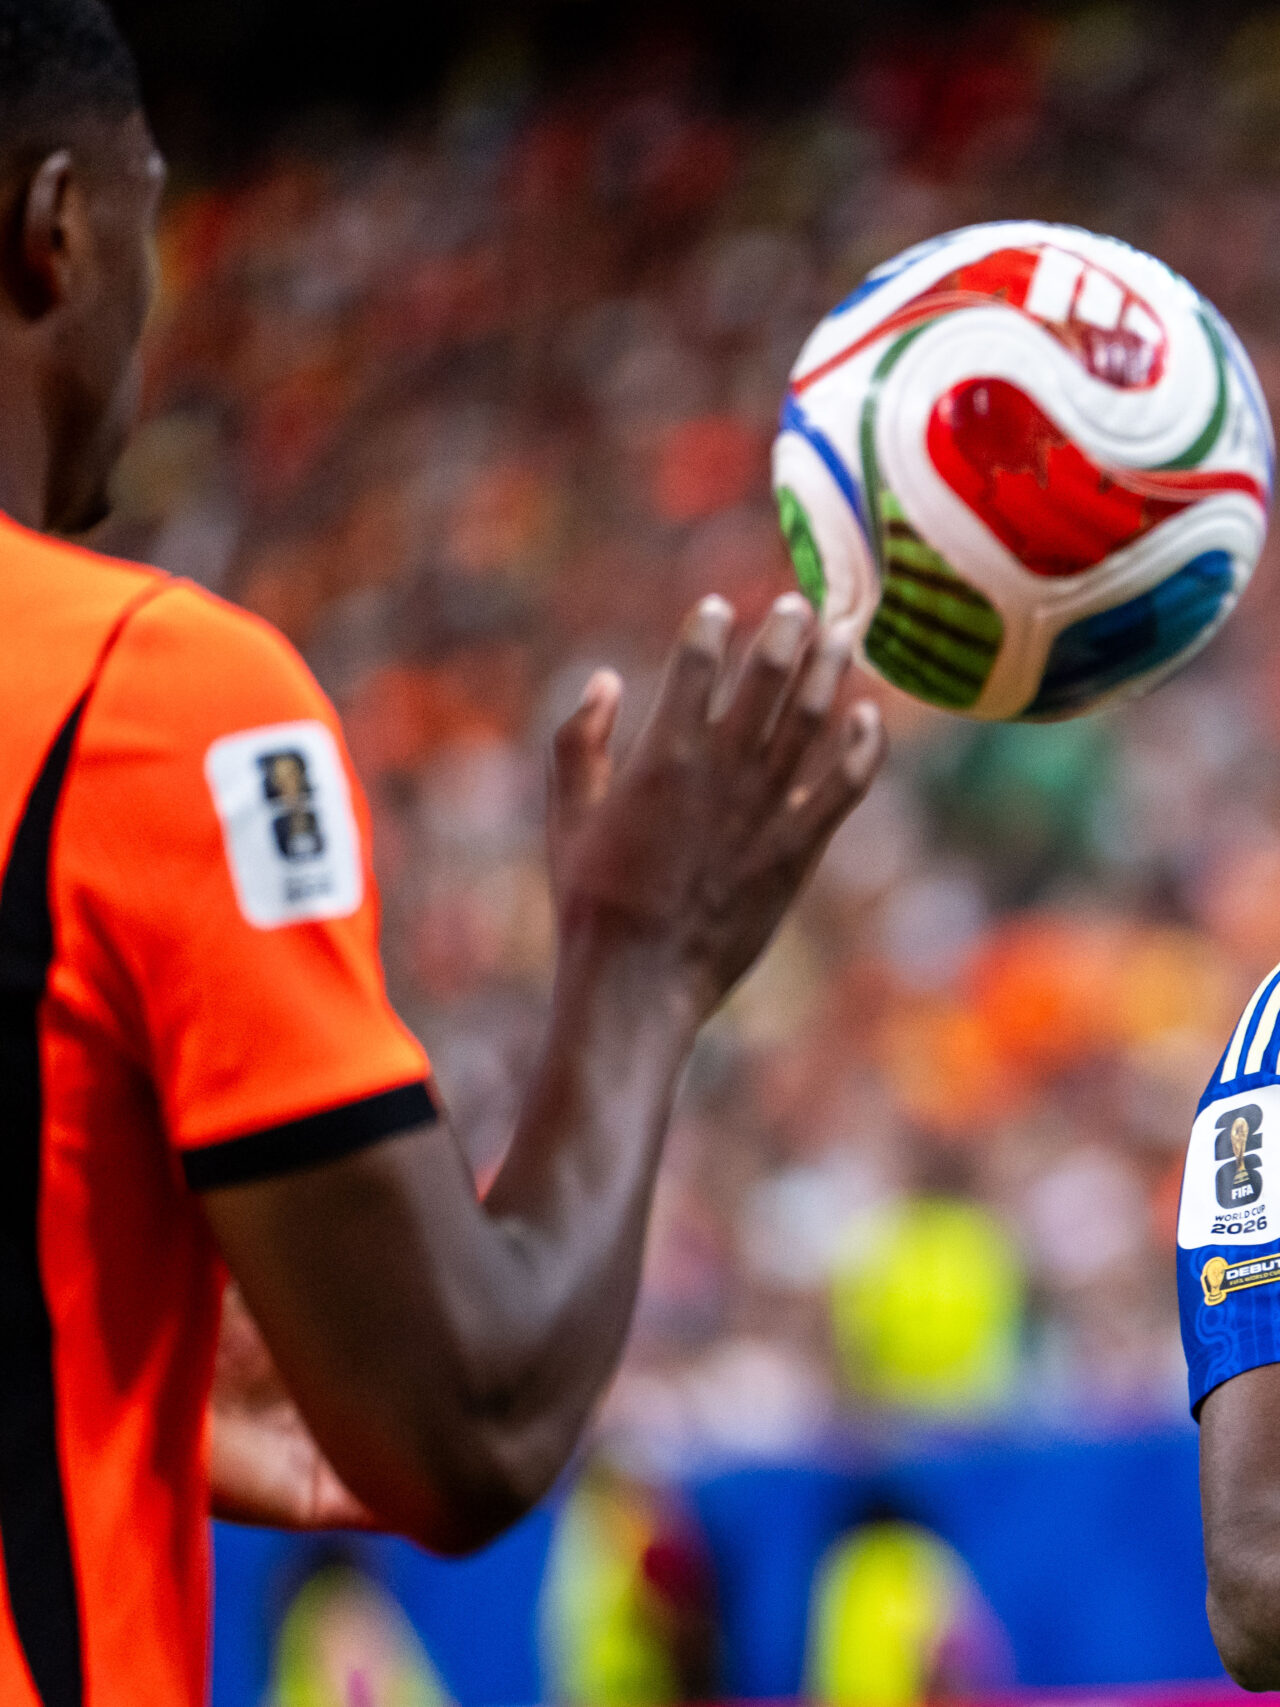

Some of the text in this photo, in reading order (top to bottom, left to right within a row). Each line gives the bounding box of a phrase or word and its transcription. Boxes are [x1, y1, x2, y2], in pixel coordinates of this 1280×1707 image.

[1231, 1184, 1254, 1200] FIFA
[1214, 1204, 1266, 1222] WORLD CUP
[1210, 1216, 1268, 1235] 2026
